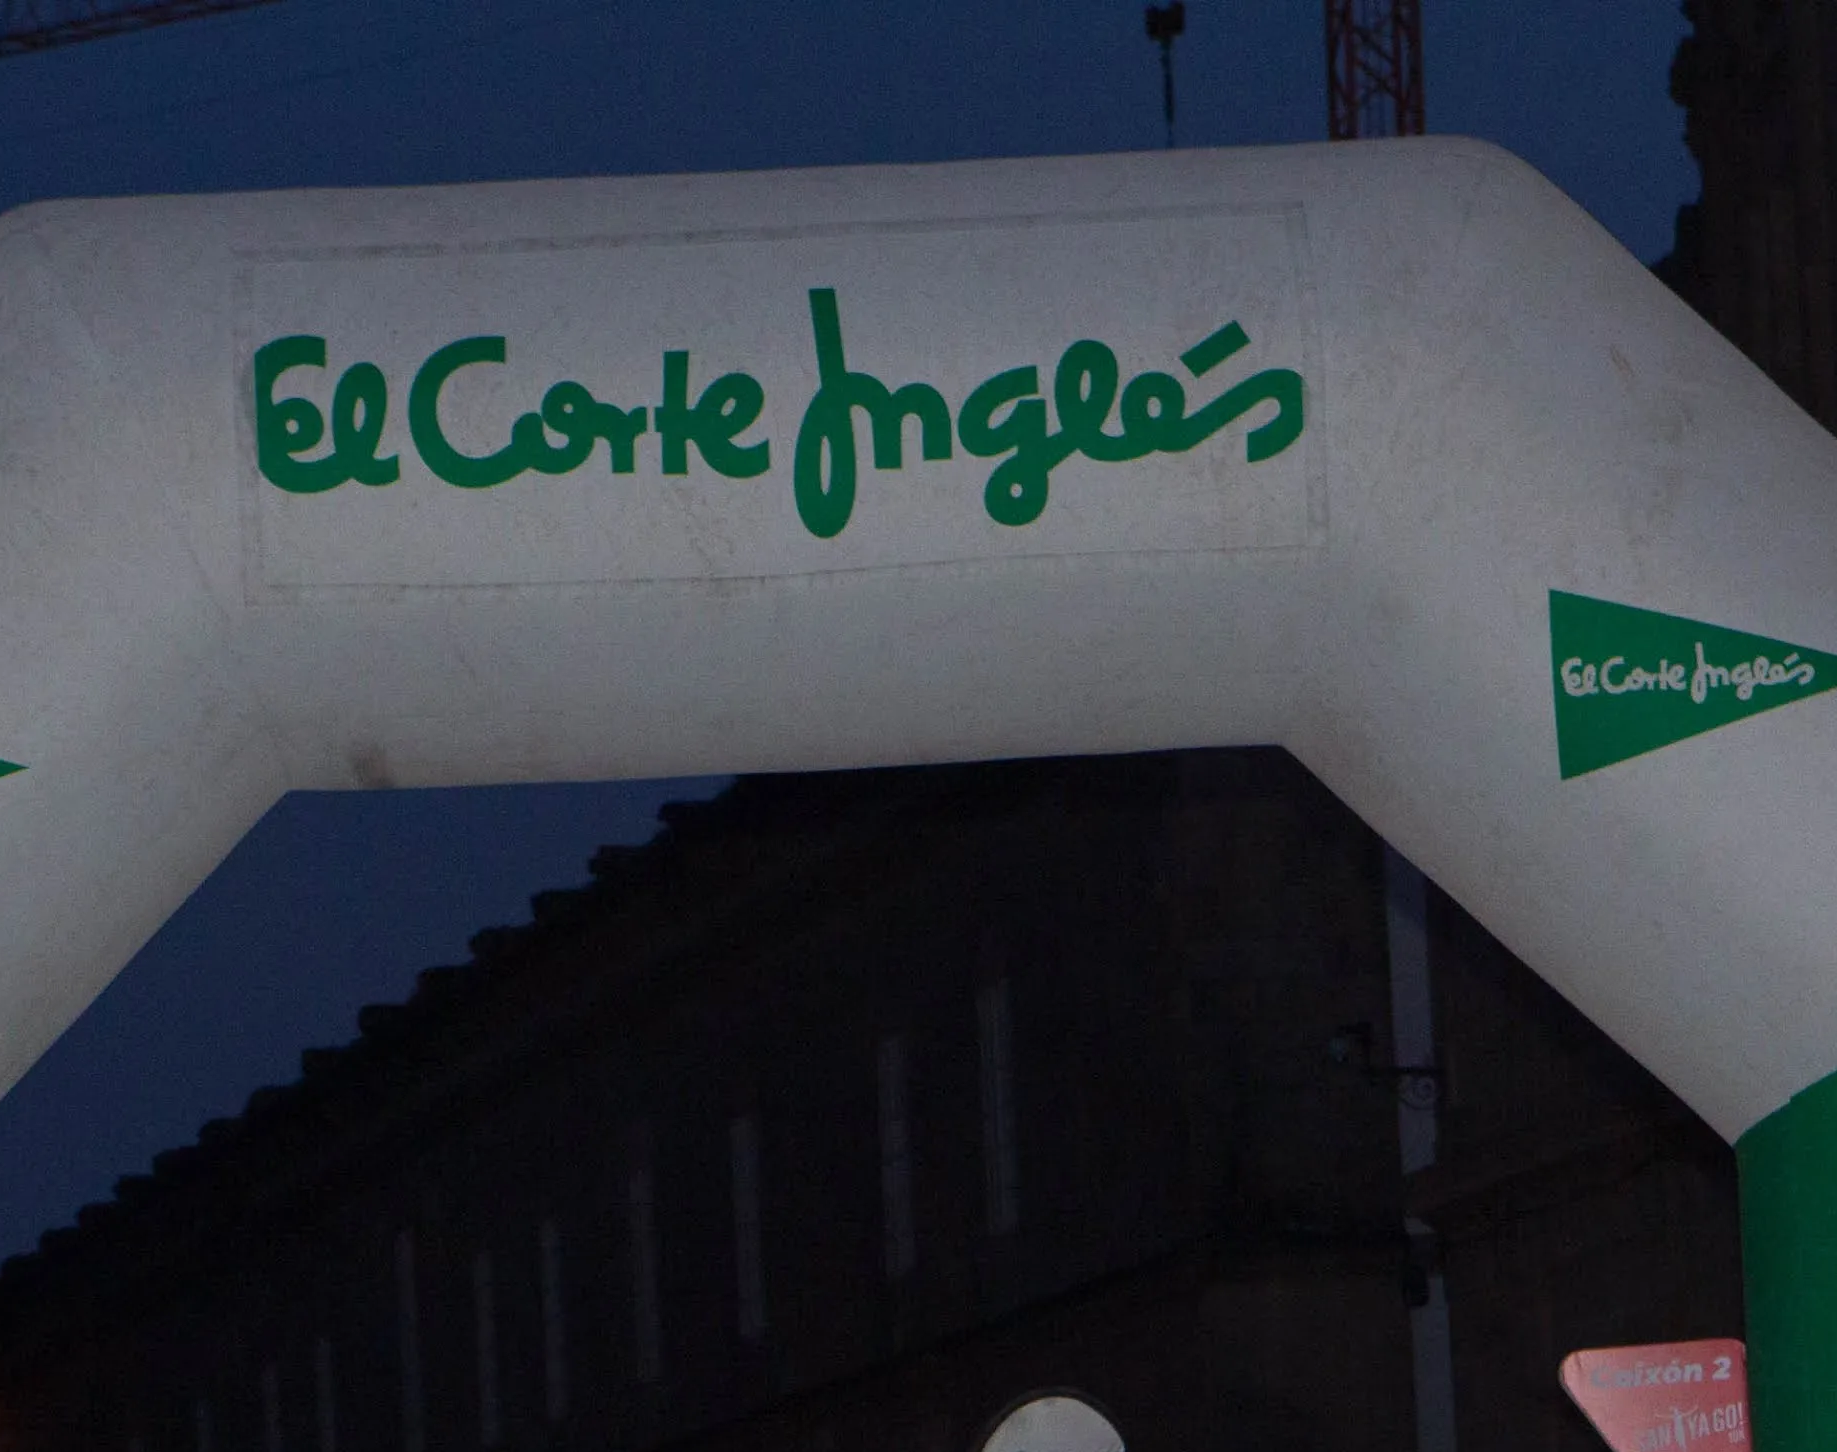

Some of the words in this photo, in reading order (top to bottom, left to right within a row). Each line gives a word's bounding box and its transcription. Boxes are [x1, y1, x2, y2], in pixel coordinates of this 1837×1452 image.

[254, 335, 400, 494] El
[408, 335, 771, 489] Corte
[794, 287, 1305, 539] Inglés
[1561, 657, 1599, 696] El
[1600, 656, 1686, 694] Corte
[1691, 642, 1815, 704] Inglés
[1589, 1358, 1703, 1391] Caixón
[1711, 1356, 1733, 1381] 2
